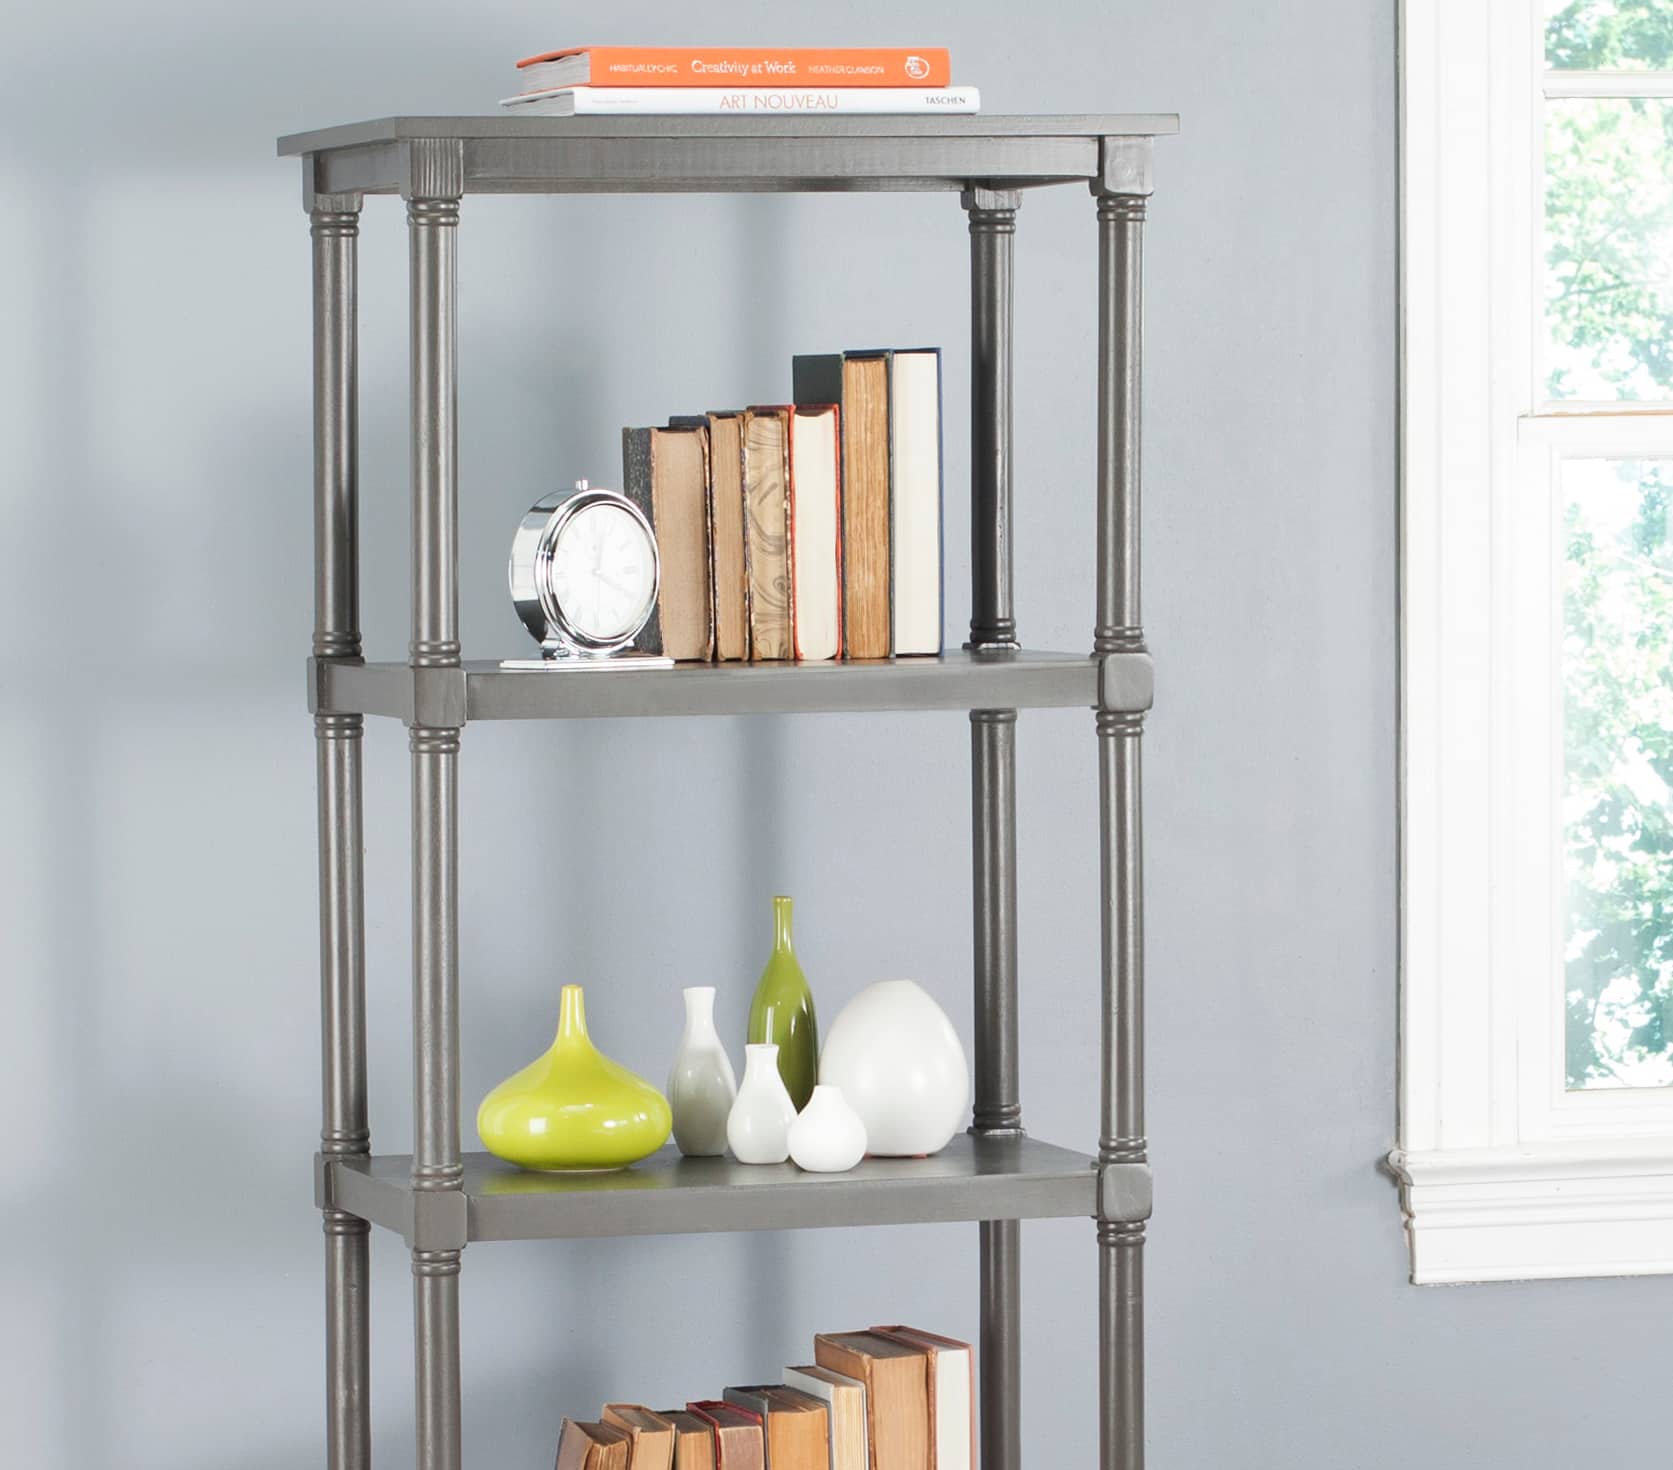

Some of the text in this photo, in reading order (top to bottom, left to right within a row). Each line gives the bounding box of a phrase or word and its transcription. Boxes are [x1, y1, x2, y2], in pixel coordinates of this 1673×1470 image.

[691, 60, 749, 76] Creativity
[752, 64, 762, 73] at
[764, 61, 797, 74] Work
[719, 95, 966, 109] ART NOUVEAU TASCHEN
